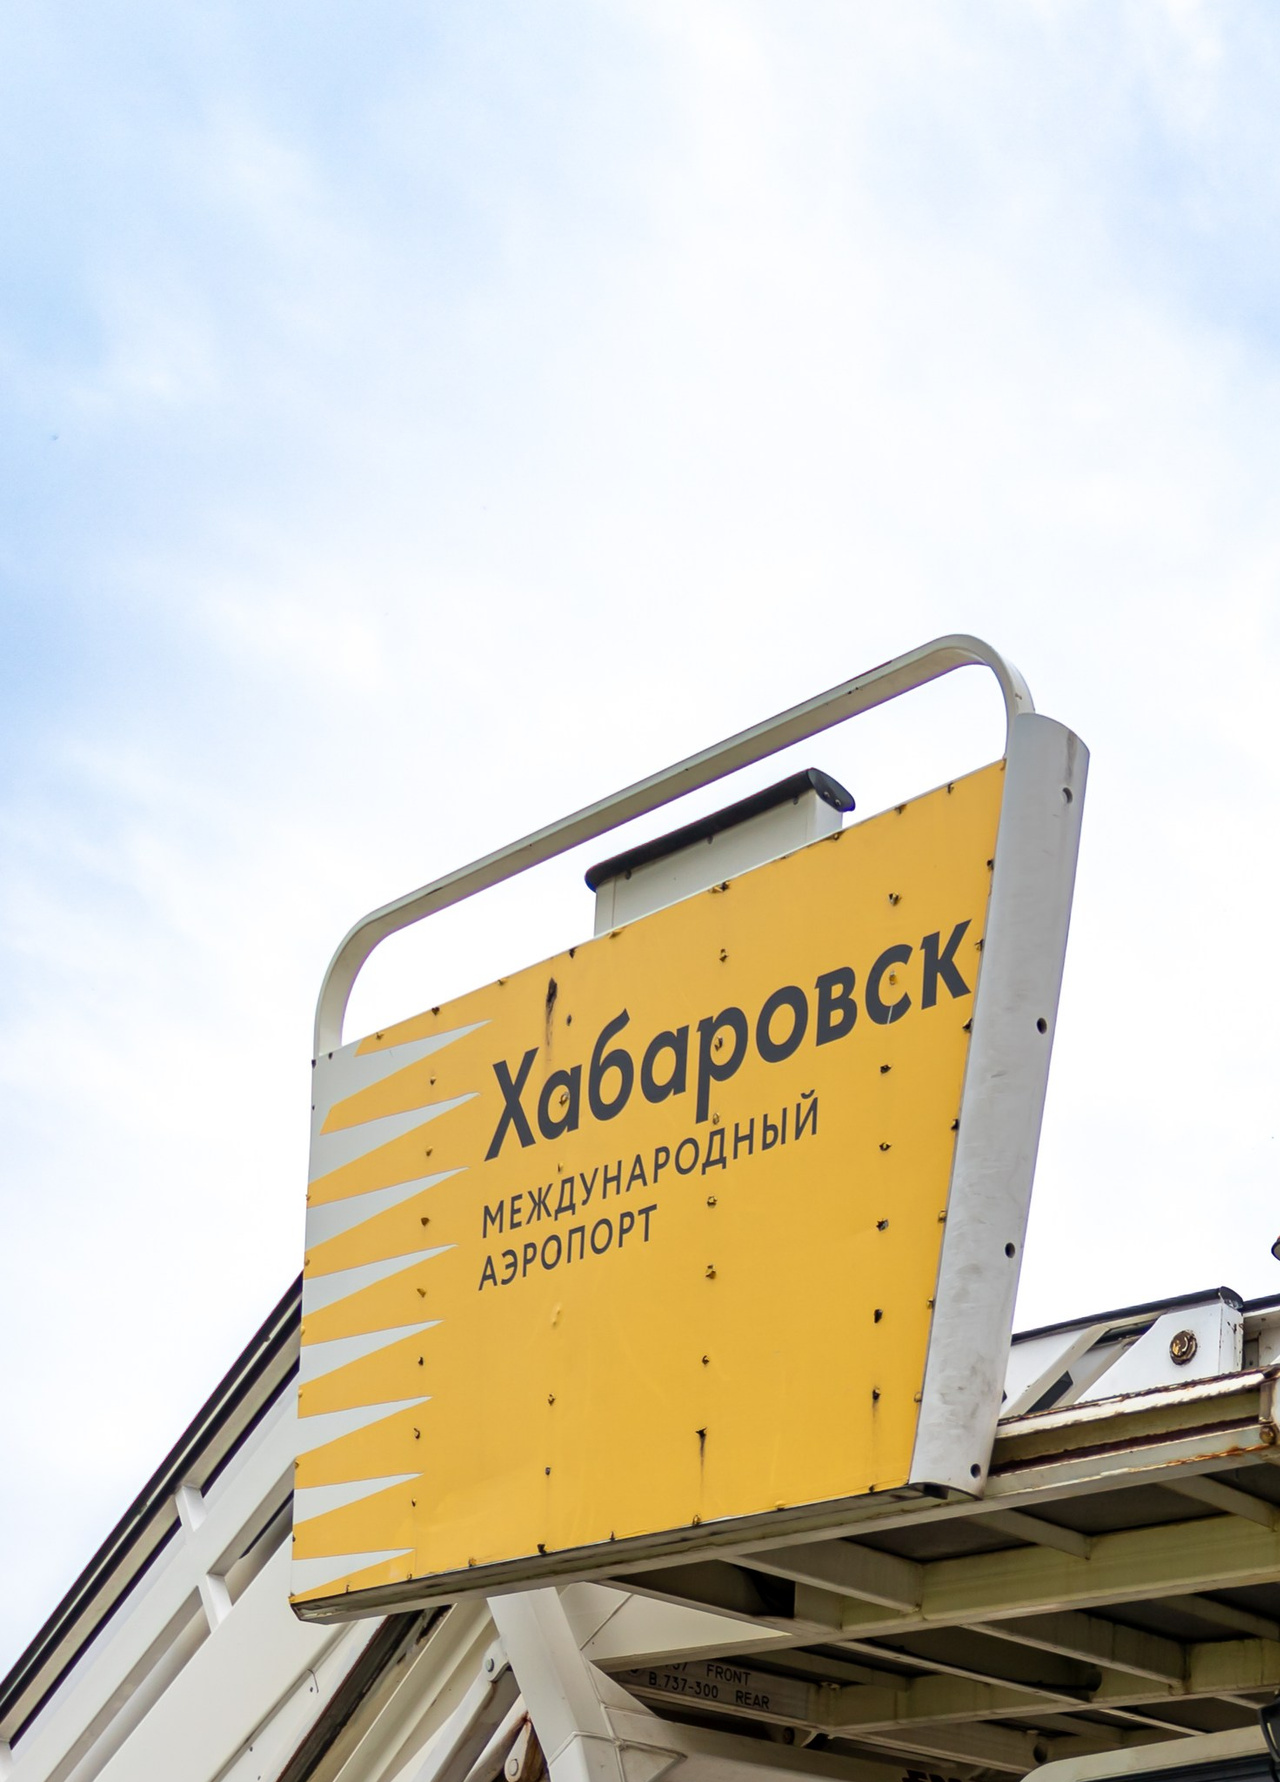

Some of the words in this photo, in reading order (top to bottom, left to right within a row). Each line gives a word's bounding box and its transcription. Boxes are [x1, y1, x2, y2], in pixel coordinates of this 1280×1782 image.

[484, 918, 973, 1162] Хабаровск
[482, 1088, 818, 1239] МЕЖДУНАРОДНЫЙ
[478, 1204, 658, 1292] АЭРОПОРТ
[648, 1671, 718, 1698] B.737-300
[735, 1690, 770, 1709] REAR
[706, 1664, 751, 1686] FRONT
